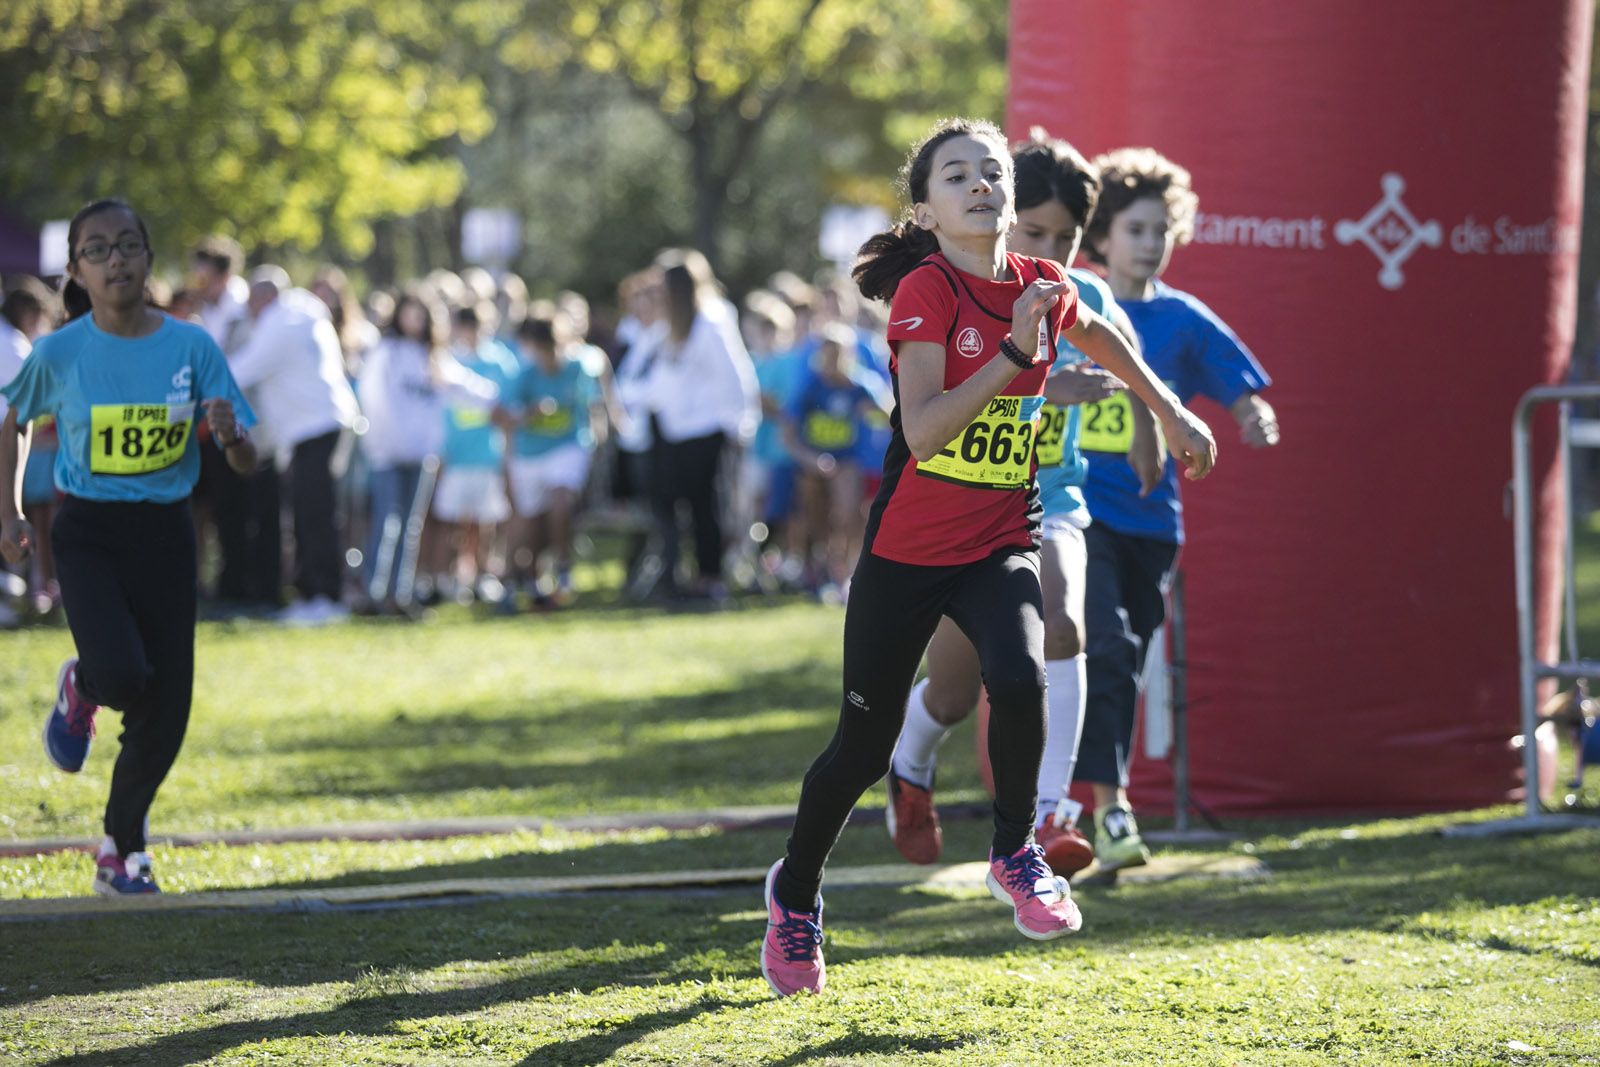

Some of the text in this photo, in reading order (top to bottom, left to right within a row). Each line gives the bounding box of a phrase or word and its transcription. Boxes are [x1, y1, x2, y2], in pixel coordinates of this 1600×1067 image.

[1450, 214, 1490, 255] de
[1086, 403, 1125, 434] 23
[98, 424, 187, 458] 1826
[940, 422, 1032, 466] 663
